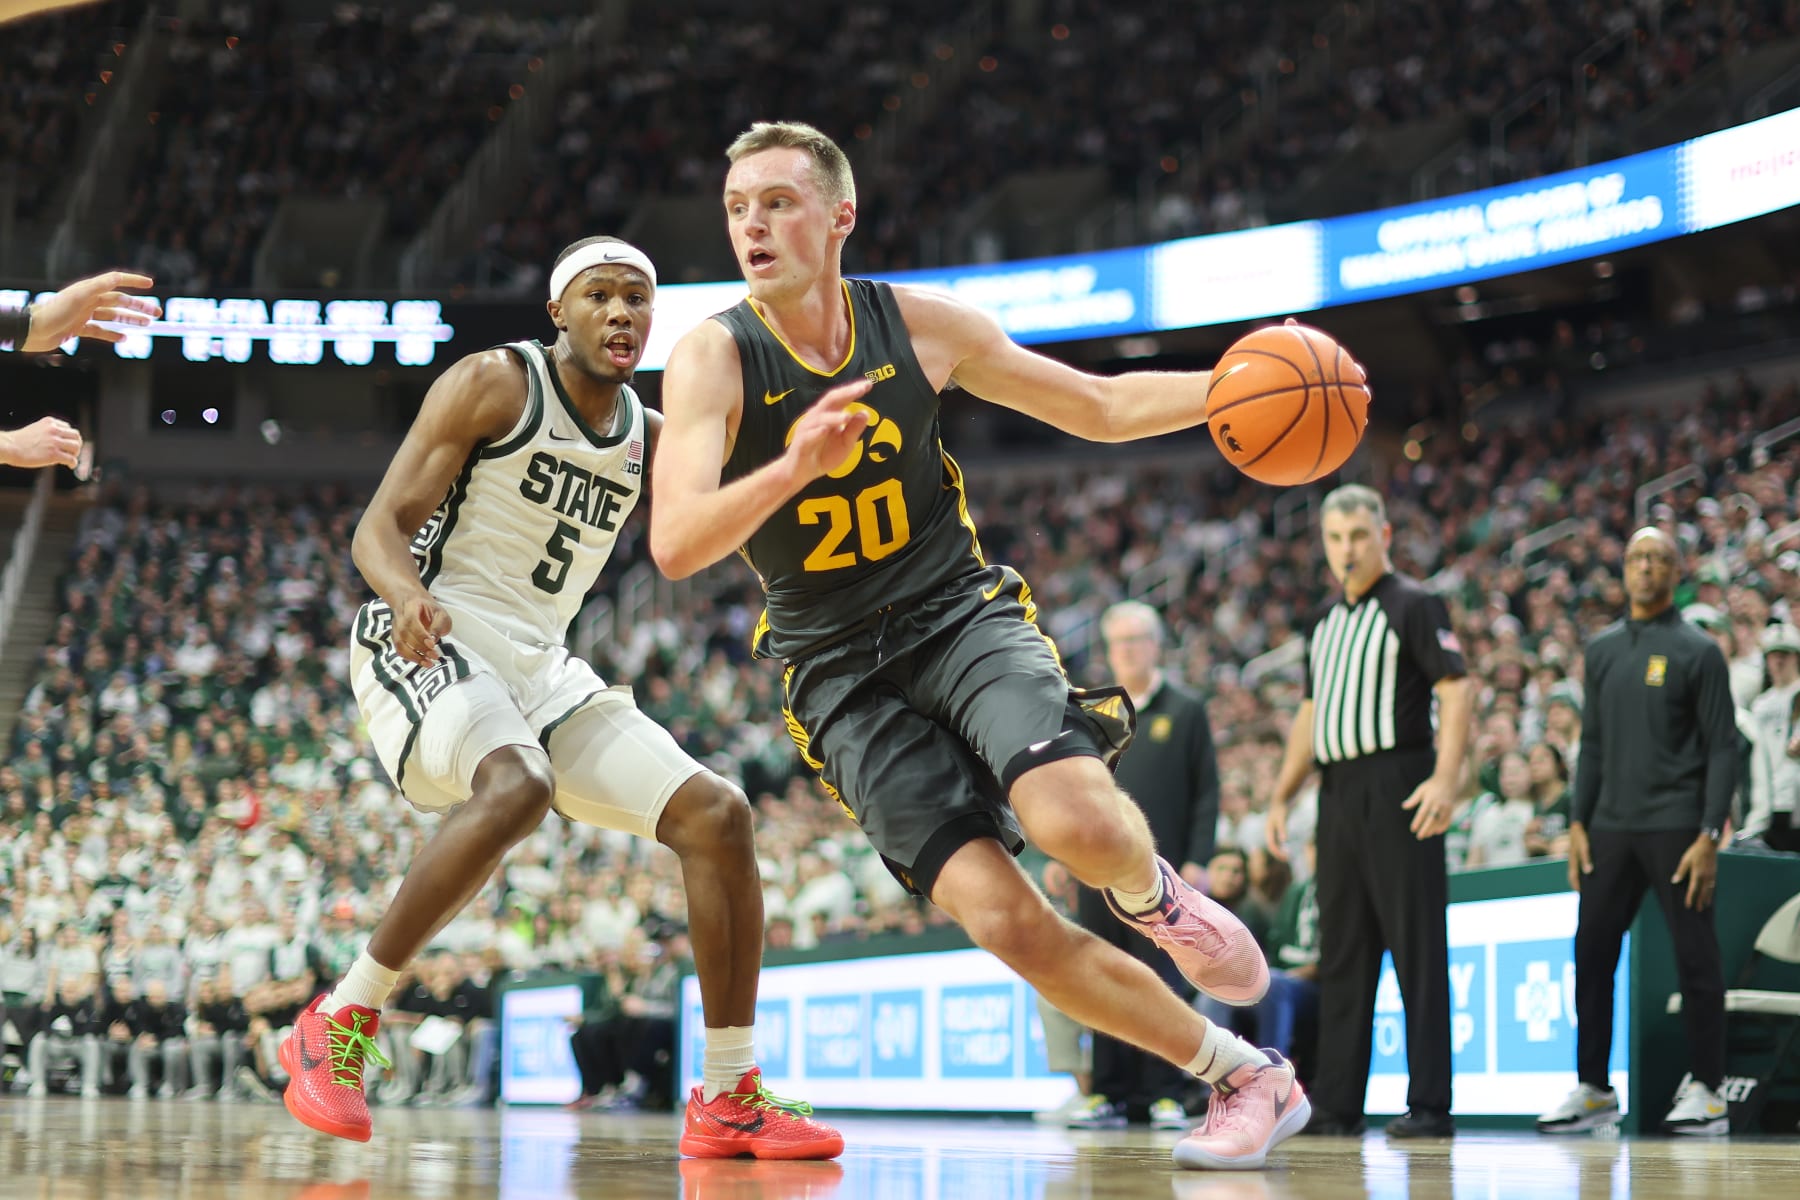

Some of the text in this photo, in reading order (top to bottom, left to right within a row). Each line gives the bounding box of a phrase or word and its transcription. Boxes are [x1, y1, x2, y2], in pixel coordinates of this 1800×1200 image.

[520, 451, 634, 532] STATE
[797, 478, 910, 572] 20
[531, 519, 581, 595] 5
